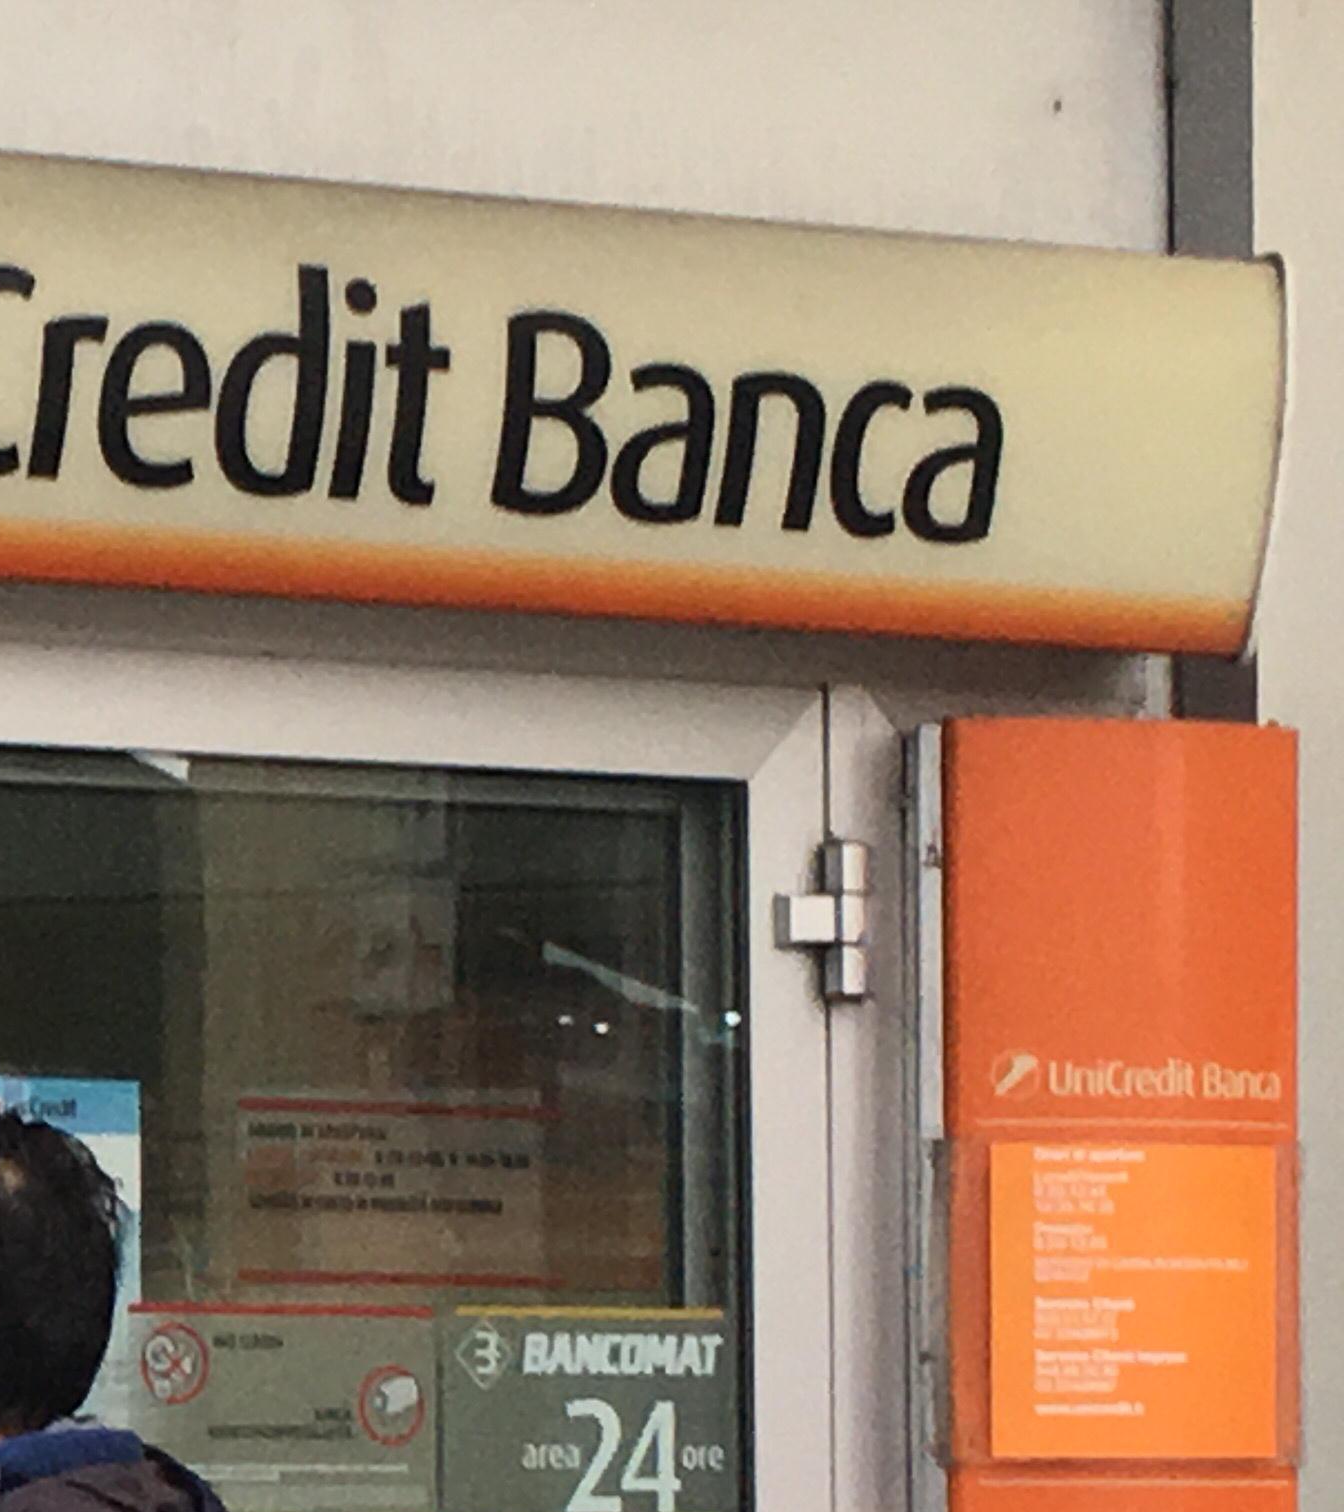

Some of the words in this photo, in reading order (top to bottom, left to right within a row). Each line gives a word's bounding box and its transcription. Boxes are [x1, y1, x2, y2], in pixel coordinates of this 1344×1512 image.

[490, 308, 1005, 545] Banca
[1049, 1058, 1195, 1097] UniCredit
[1202, 1062, 1281, 1100] Banca
[523, 1332, 723, 1375] BANCOMAT
[521, 1443, 581, 1470] area
[681, 1444, 725, 1471] ore
